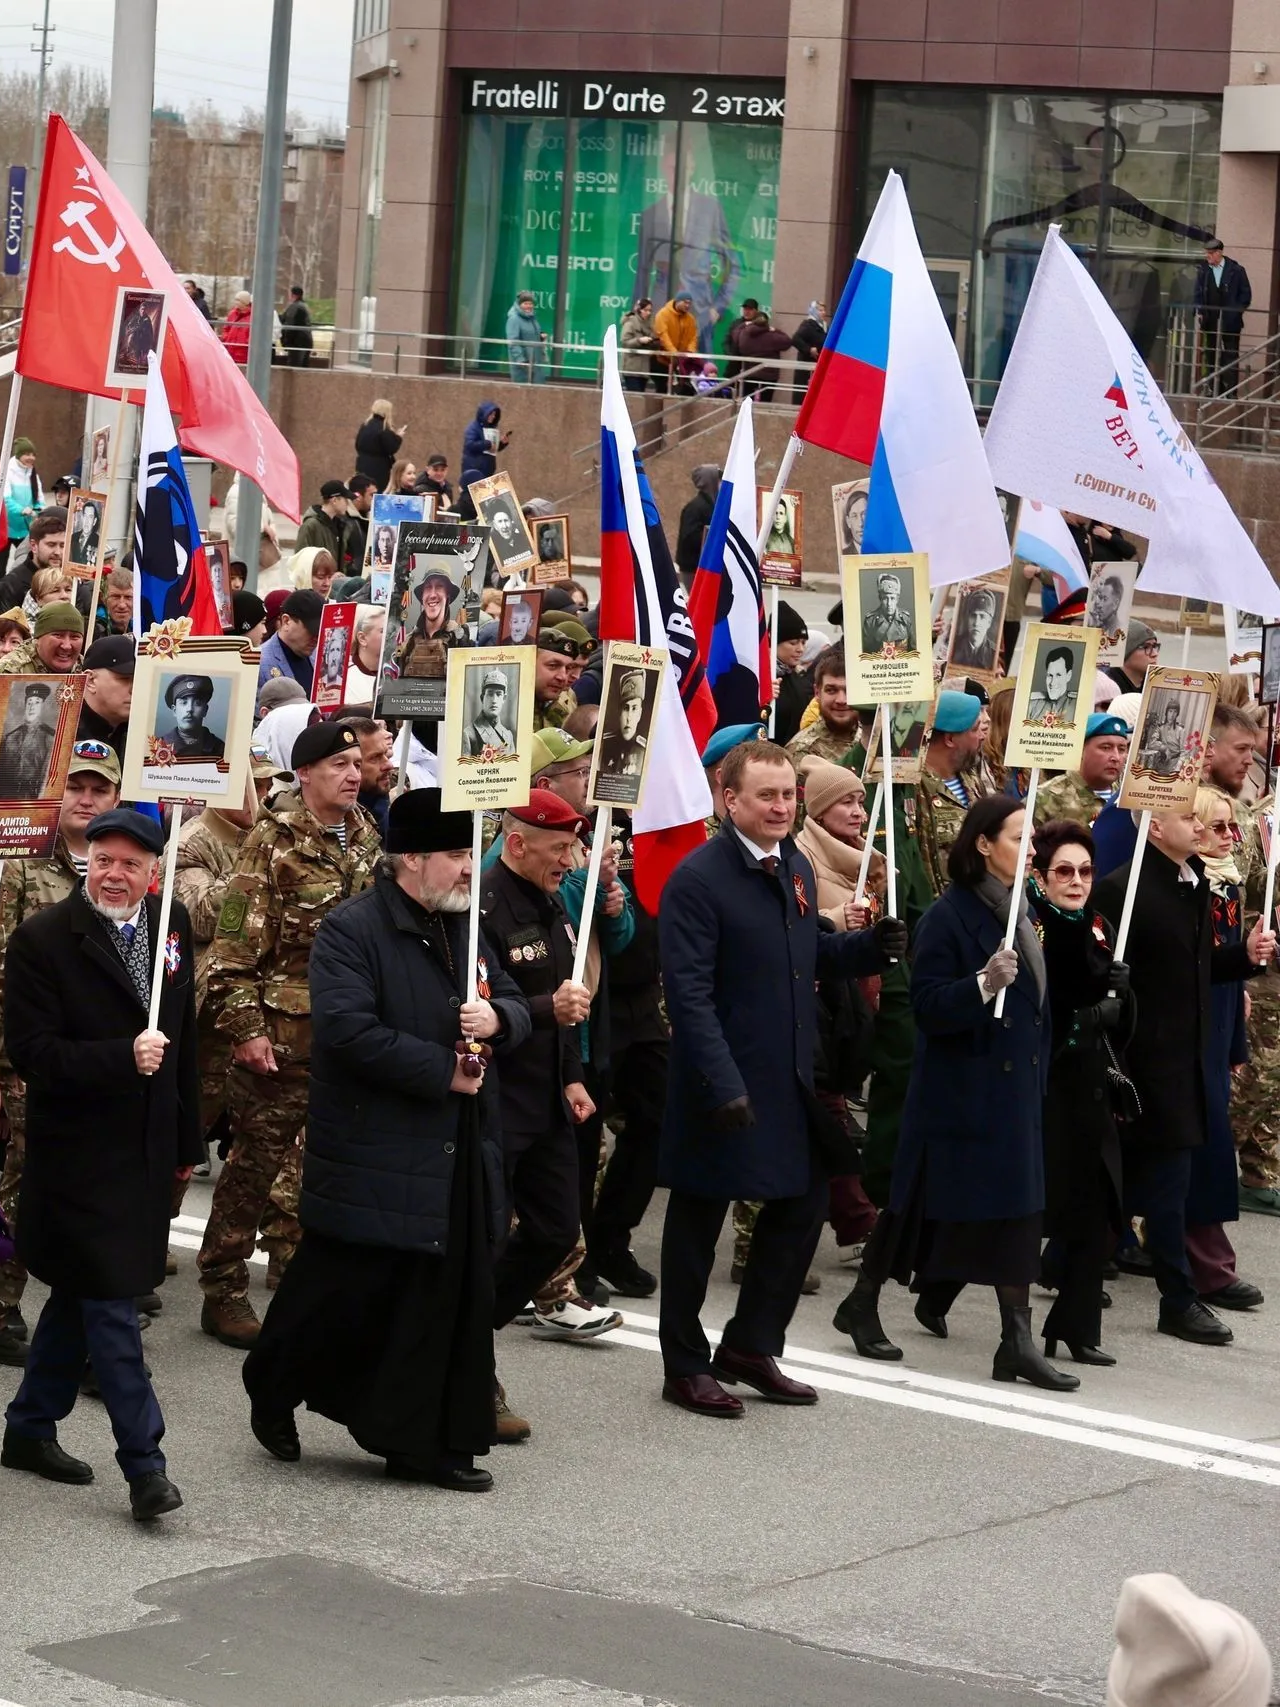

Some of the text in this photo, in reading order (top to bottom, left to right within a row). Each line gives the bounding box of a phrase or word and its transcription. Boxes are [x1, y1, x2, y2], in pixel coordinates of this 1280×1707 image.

[472, 80, 559, 109] Fratelli
[691, 87, 786, 118] 2 этаж
[555, 171, 618, 184] RBSON
[861, 671, 920, 679] Николай Андреевич
[1030, 731, 1066, 740] КОЖАНЧИКОВ
[476, 768, 500, 776] ЧЕРНЯК
[148, 773, 172, 781] Шувалов
[191, 777, 221, 785] Андреевич
[458, 776, 517, 786] Соломон Яковлевич
[1128, 791, 1156, 799] АЛЕКСАНДР
[2, 826, 49, 836] АХМАТОВИЧ
